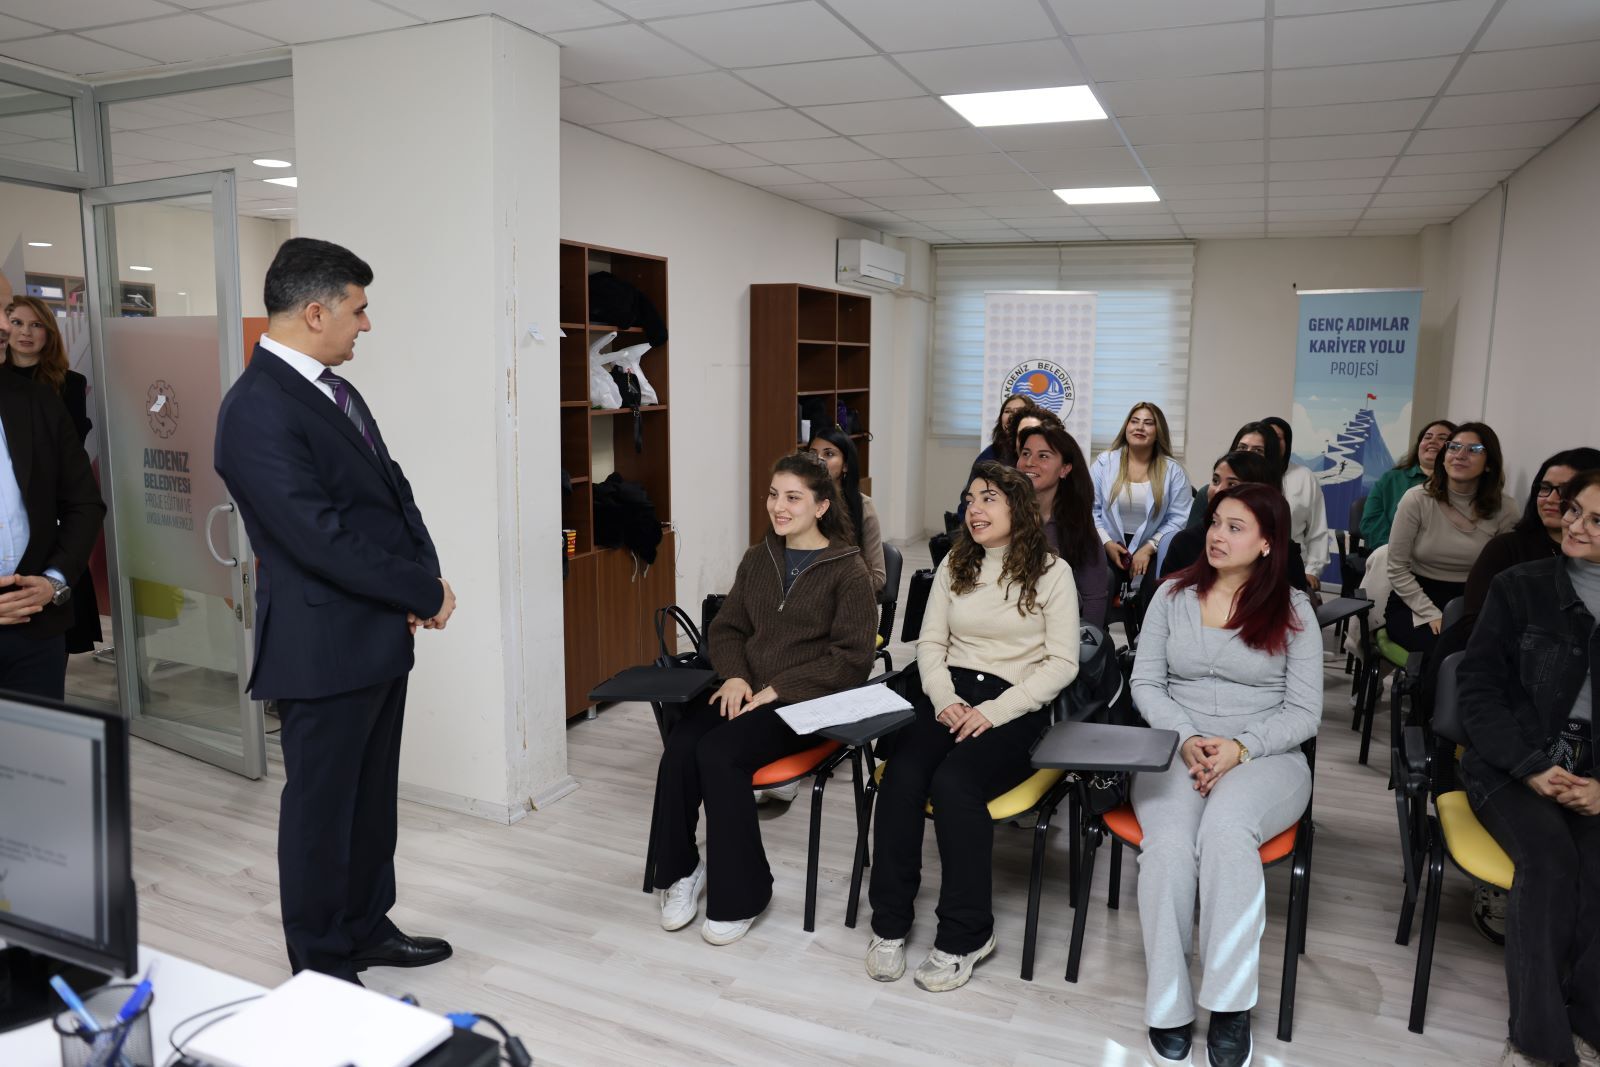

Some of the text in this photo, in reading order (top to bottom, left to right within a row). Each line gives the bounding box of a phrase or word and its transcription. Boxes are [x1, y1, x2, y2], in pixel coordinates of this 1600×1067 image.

[1308, 316, 1410, 334] GENÇ ADIMLAR
[1309, 336, 1406, 354] KARİYER YOLU
[1330, 360, 1380, 378] PROJESİ
[1004, 362, 1074, 400] AKDENİZ BELEDİYESİ
